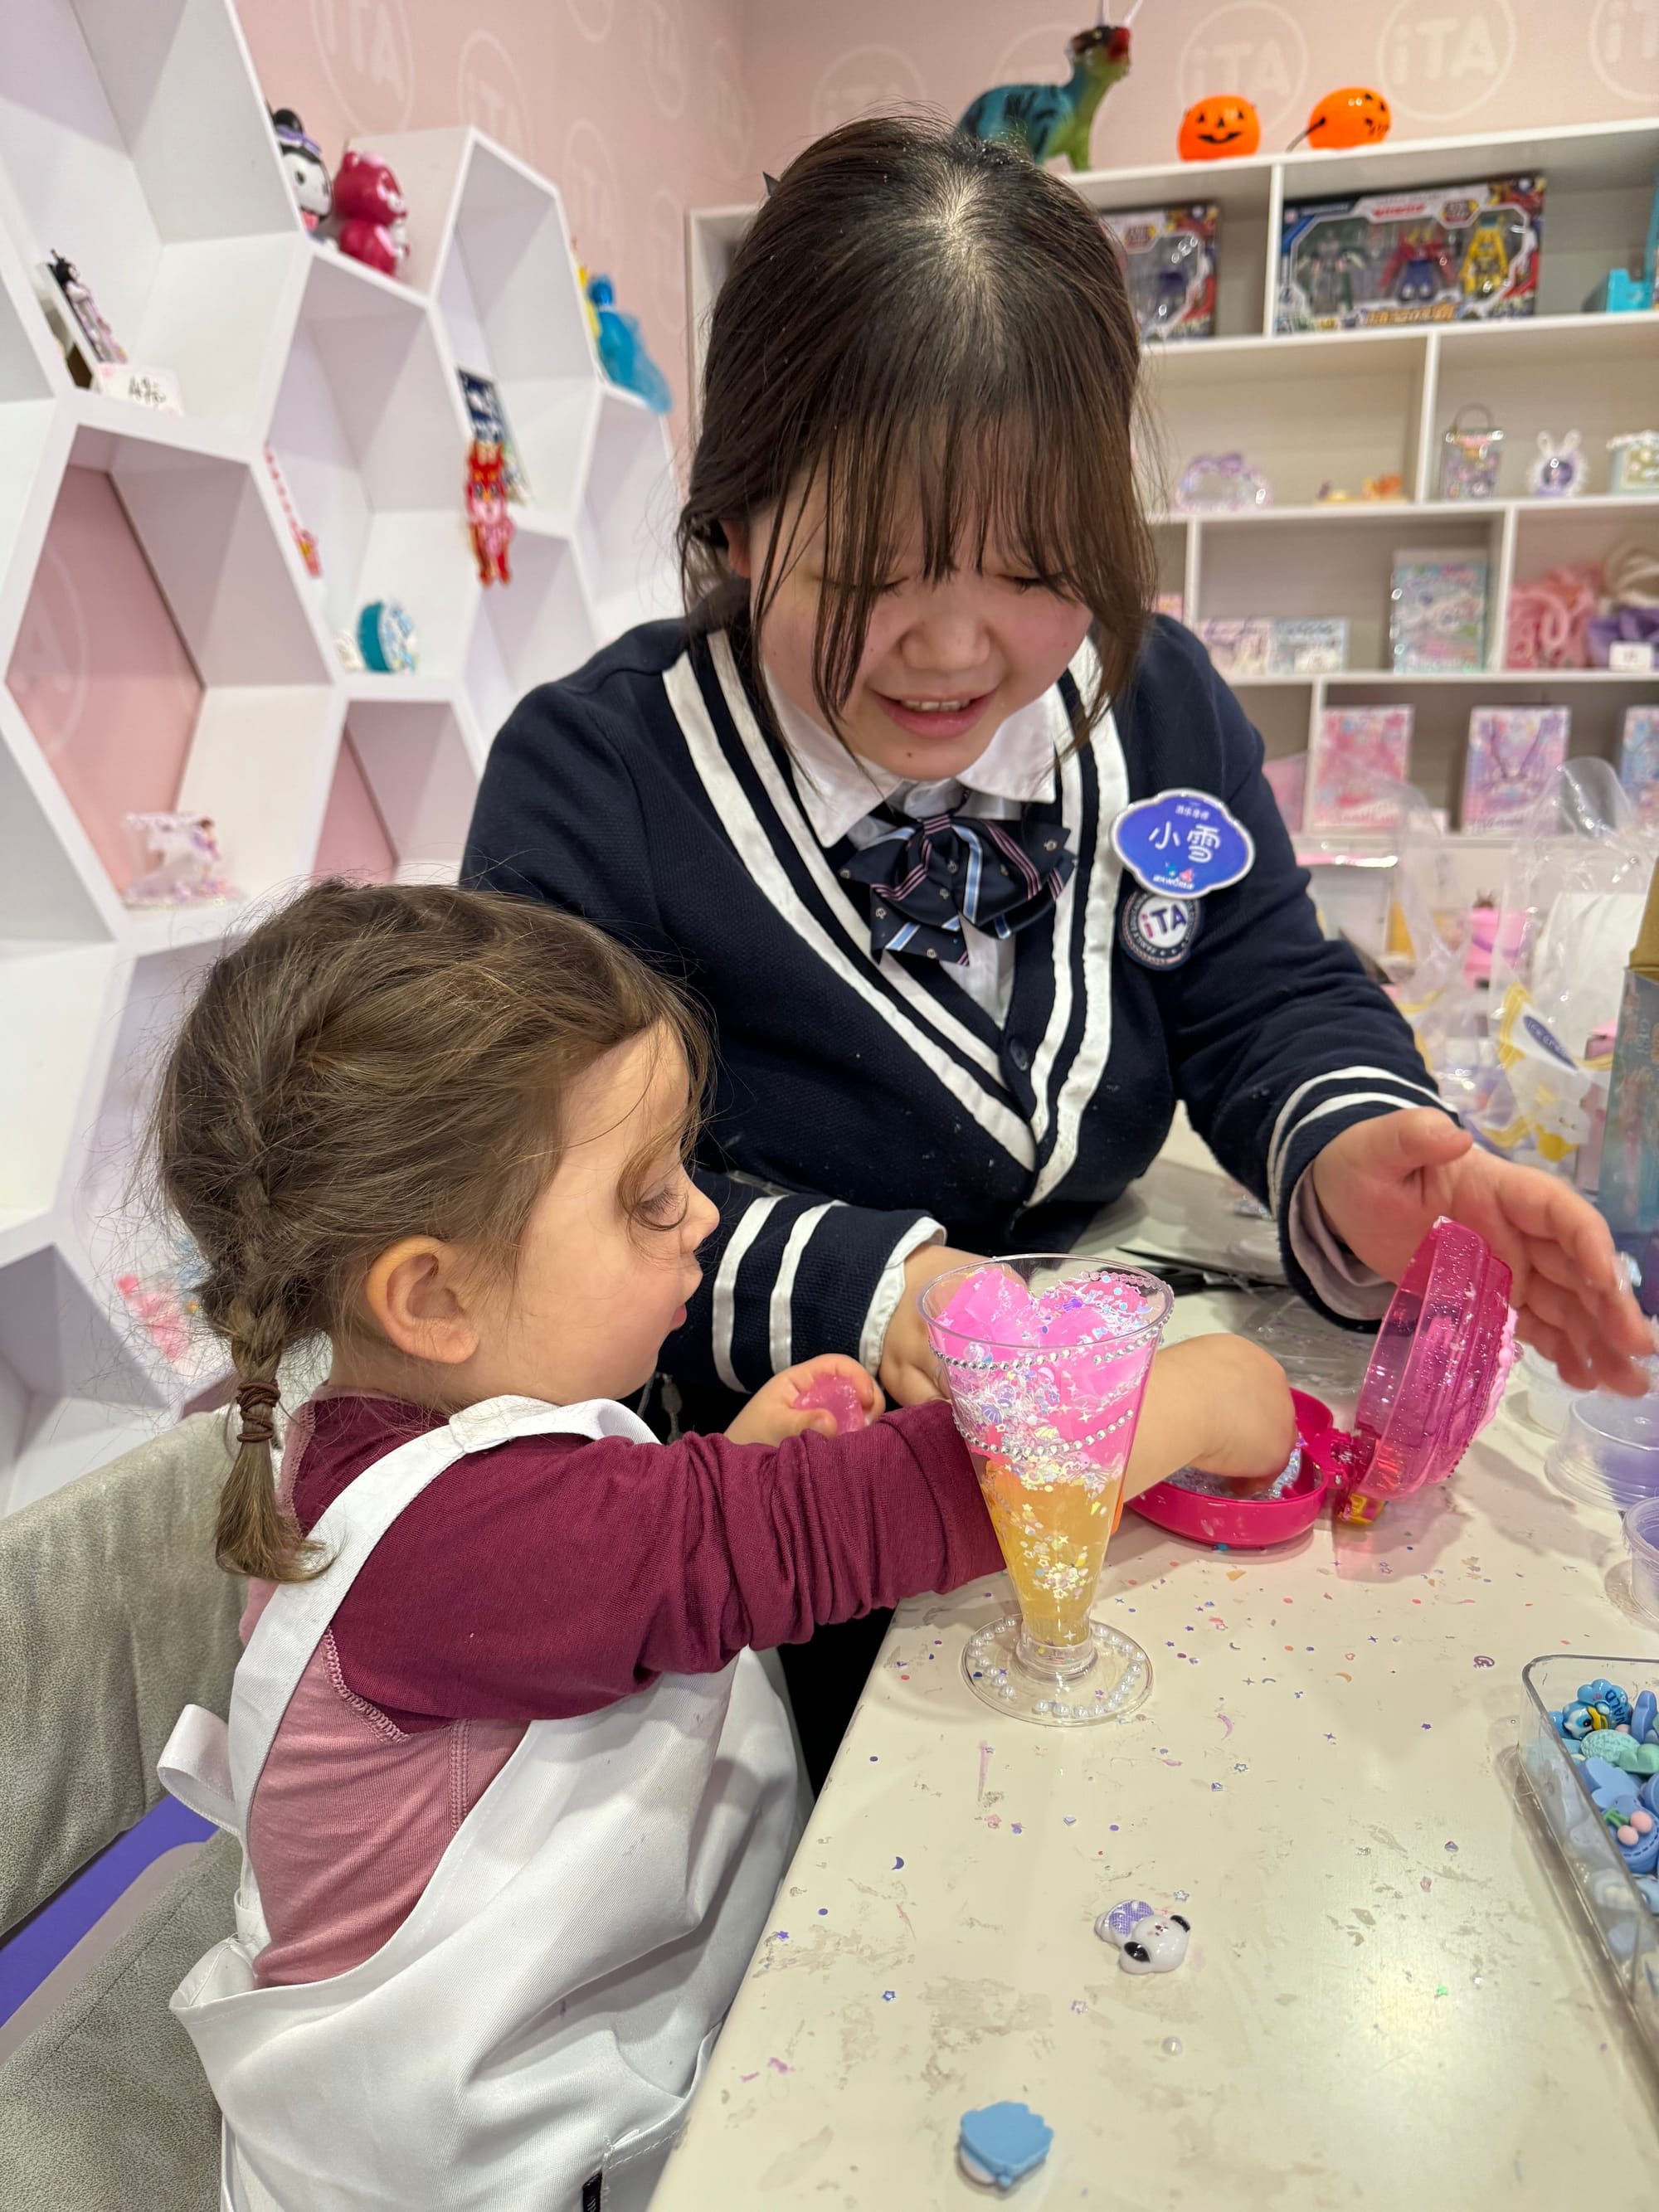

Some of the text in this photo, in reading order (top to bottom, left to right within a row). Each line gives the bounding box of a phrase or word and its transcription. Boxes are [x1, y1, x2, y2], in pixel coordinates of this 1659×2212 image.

[1190, 40, 1291, 97] iTA
[1390, 15, 1499, 85] iTA
[1148, 819, 1222, 863] 小雪
[1141, 903, 1187, 939] iTA
[1605, 1689, 1626, 1726] NALD
